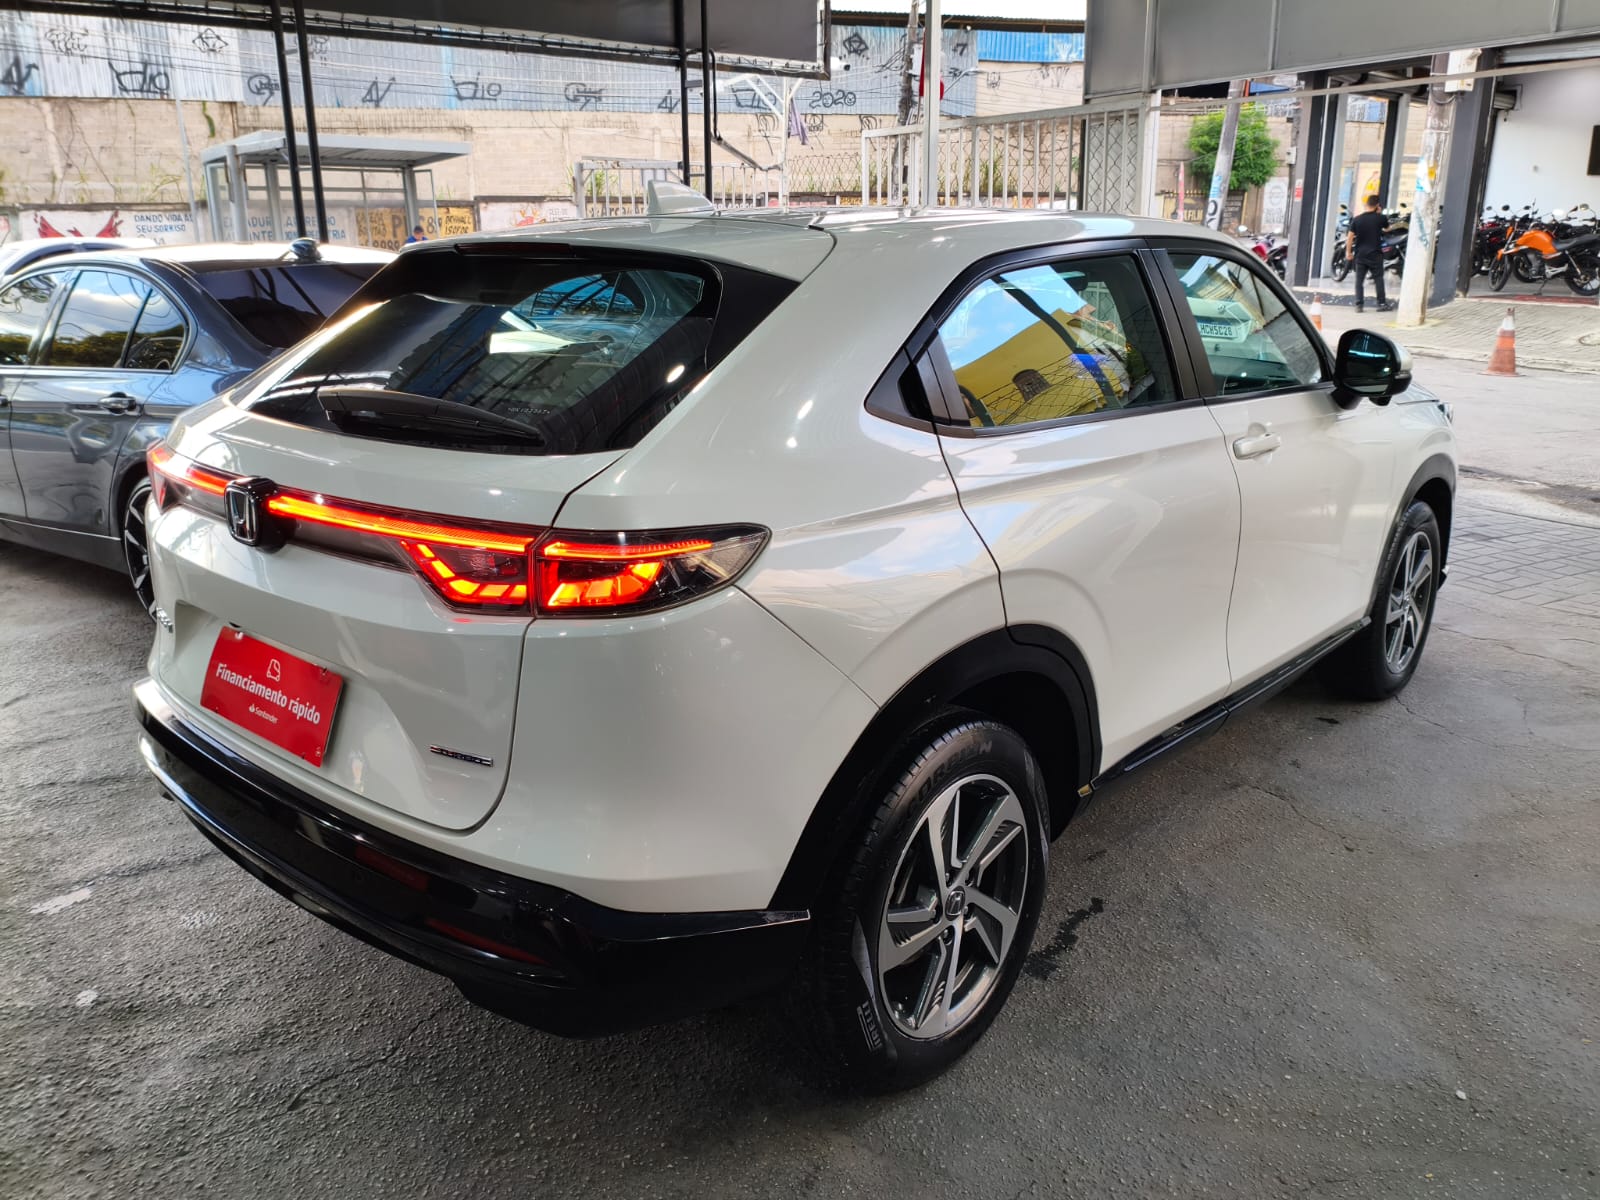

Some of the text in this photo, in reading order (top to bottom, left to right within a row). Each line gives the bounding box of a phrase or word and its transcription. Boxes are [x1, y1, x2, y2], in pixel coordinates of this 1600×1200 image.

[809, 90, 856, 109] 2020
[134, 214, 163, 223] DANDO
[164, 213, 183, 222] VIDA
[136, 224, 186, 234] SEU SORRISO
[215, 663, 321, 725] Financiamento rápido
[255, 707, 279, 724] Santander
